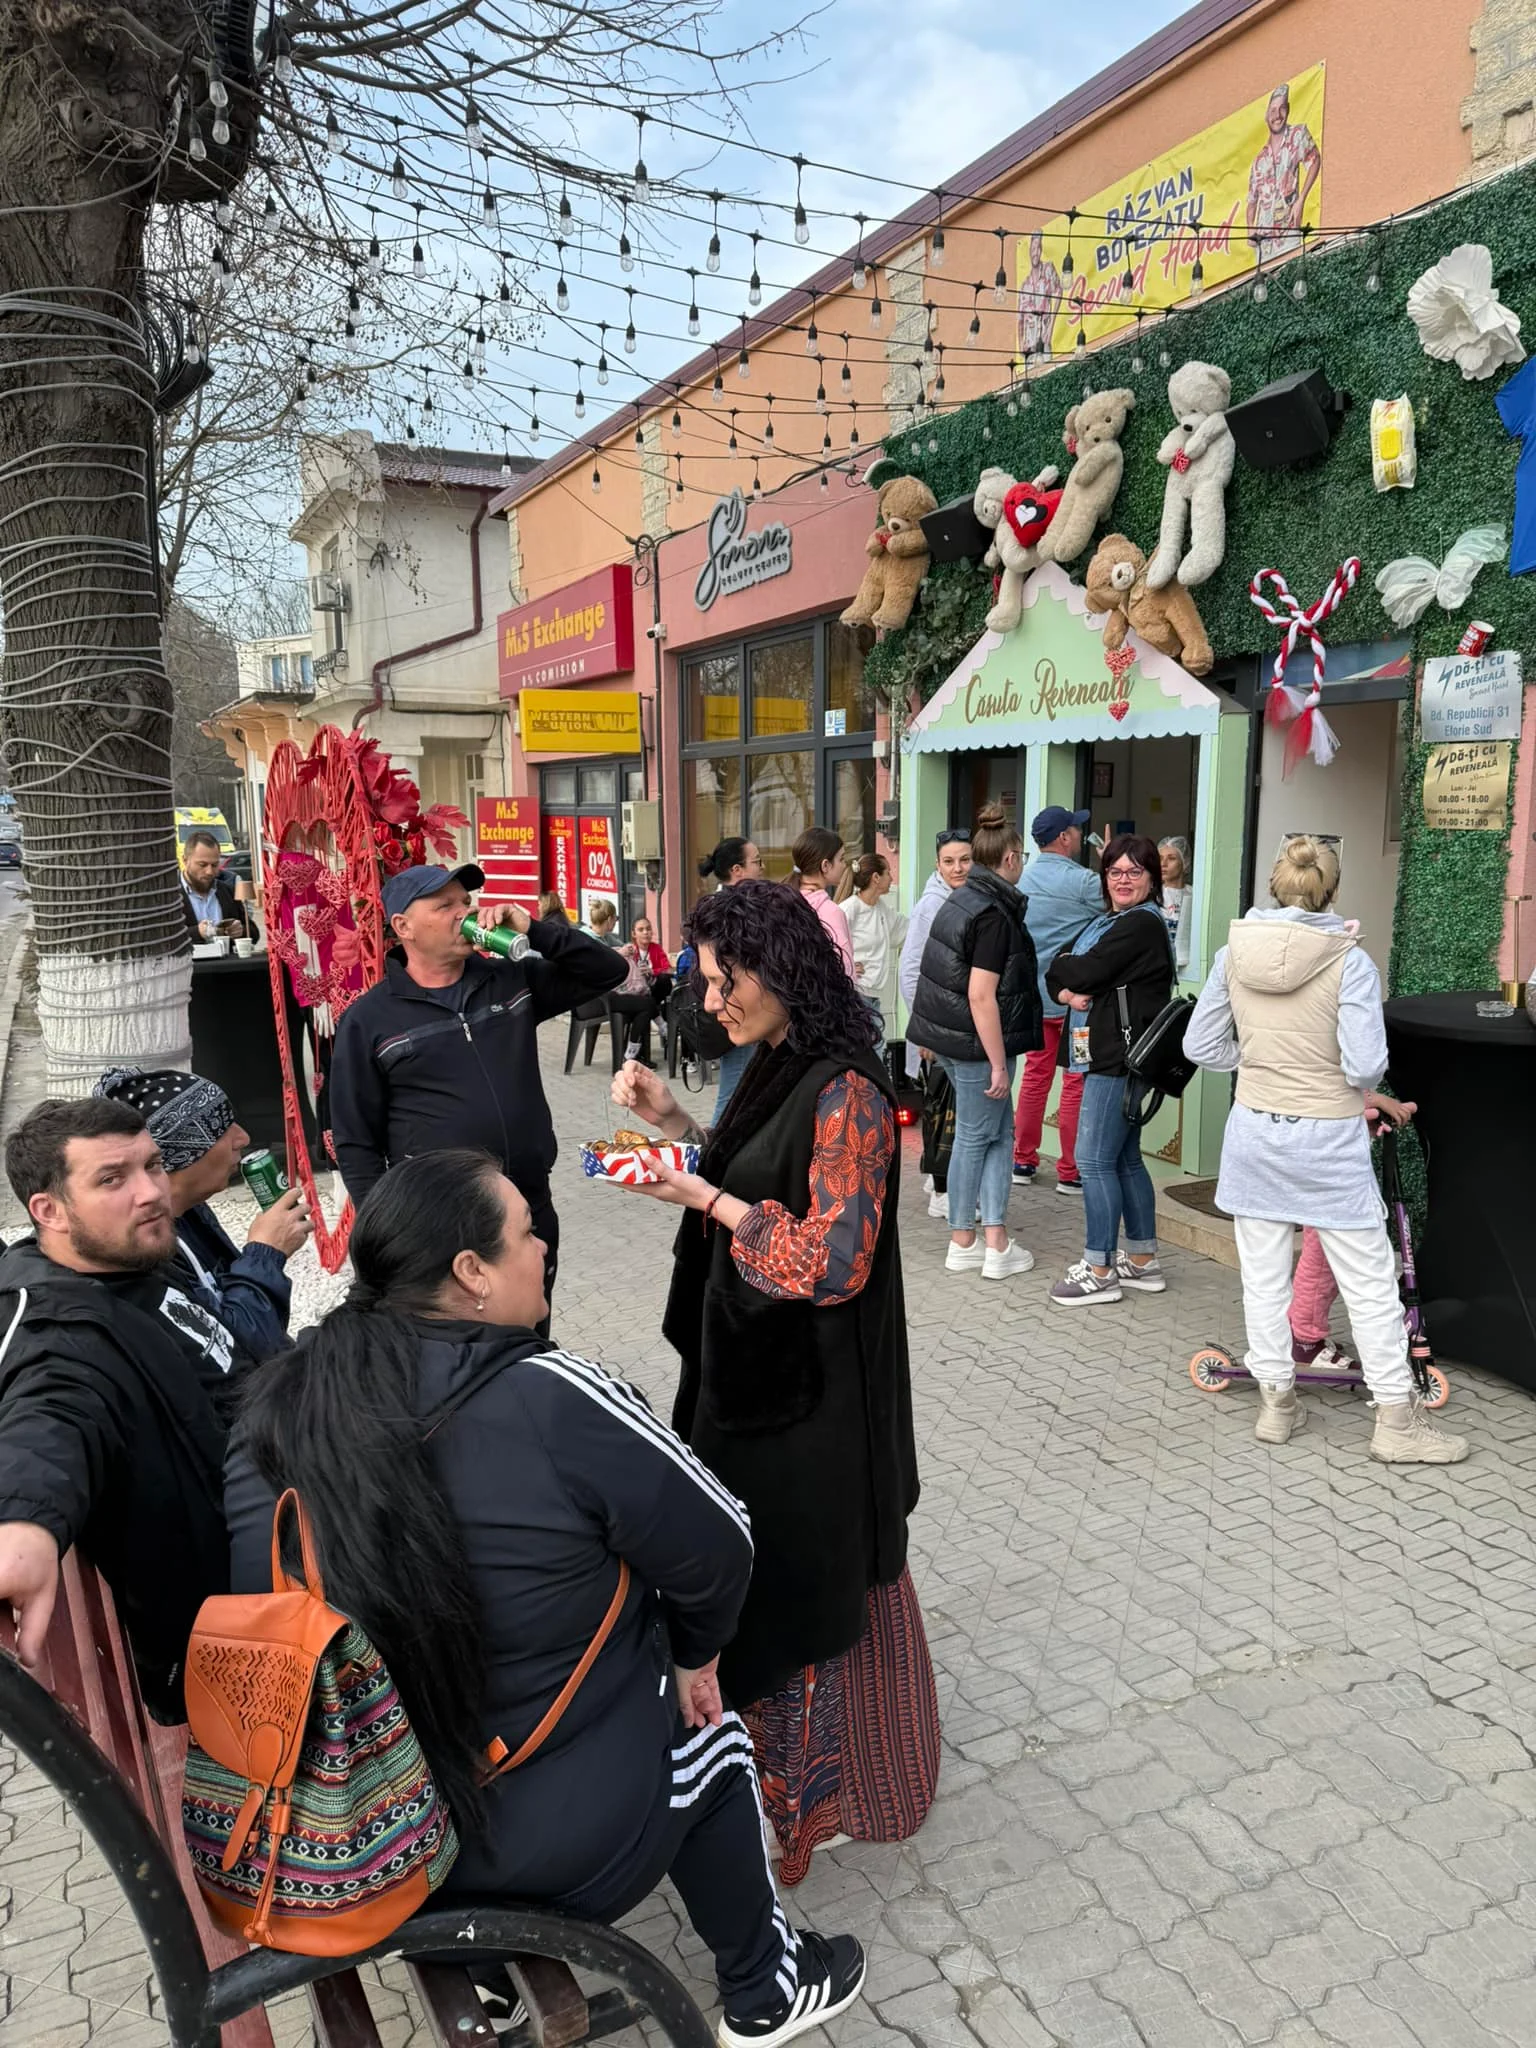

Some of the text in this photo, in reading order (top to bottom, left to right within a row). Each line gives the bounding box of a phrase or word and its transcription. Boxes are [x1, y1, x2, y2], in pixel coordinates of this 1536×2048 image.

[1160, 201, 1240, 286] Hand
[695, 493, 787, 606] Simona
[533, 601, 605, 648] Exchange
[1490, 655, 1505, 666] cu
[536, 658, 585, 684] COMISION
[529, 711, 591, 721] WESTERN
[1430, 706, 1510, 722] Bd. Republicii 31
[550, 721, 593, 730] UNION
[1473, 723, 1492, 735] Sud
[1482, 745, 1496, 755] cu
[1467, 795, 1489, 803] 18:00
[1465, 818, 1489, 826] 21:00
[480, 821, 535, 845] Exchange
[588, 852, 611, 878] 0%
[1080, 1280, 1098, 1294] N
